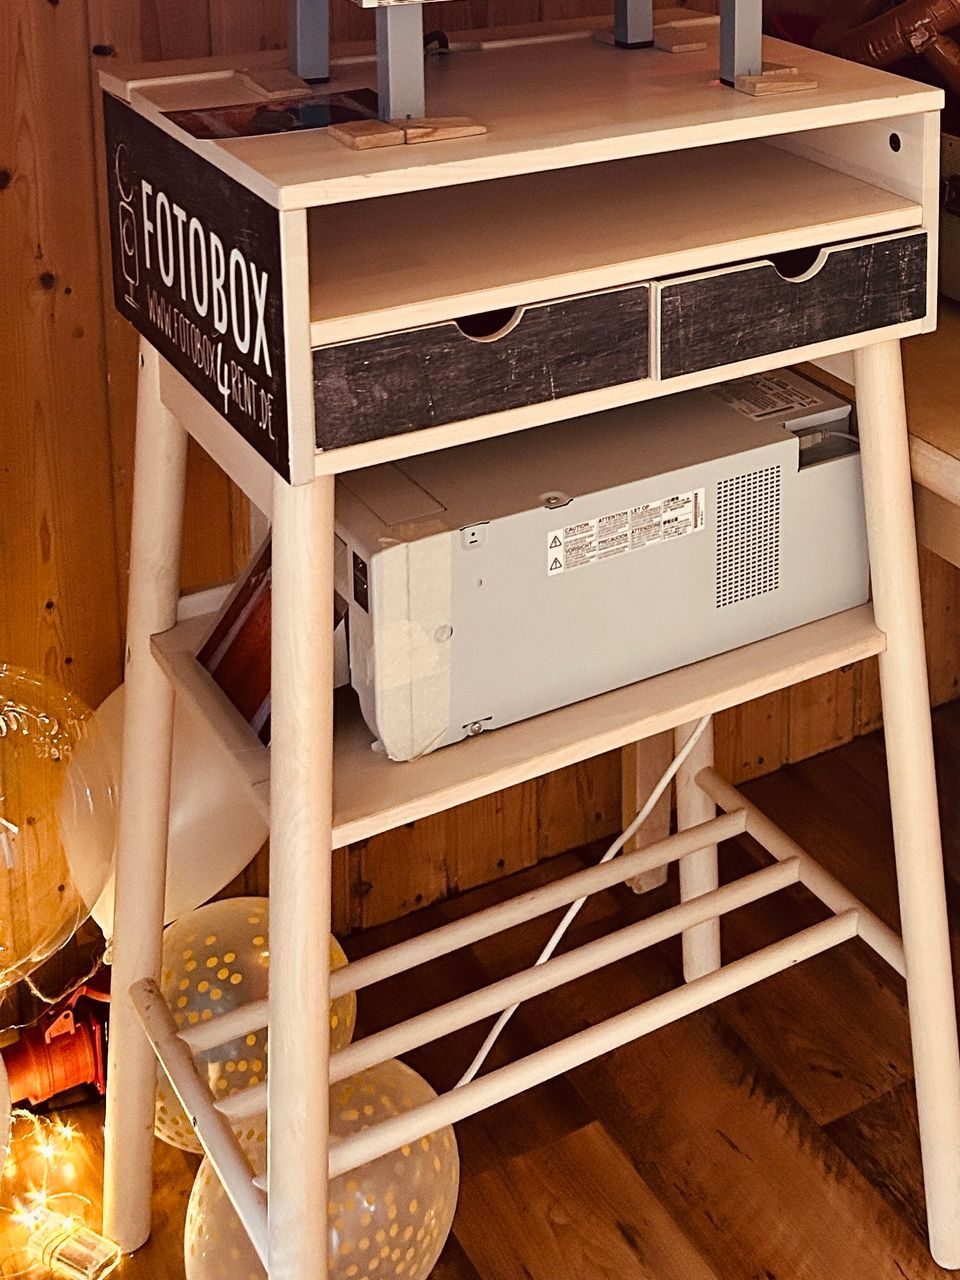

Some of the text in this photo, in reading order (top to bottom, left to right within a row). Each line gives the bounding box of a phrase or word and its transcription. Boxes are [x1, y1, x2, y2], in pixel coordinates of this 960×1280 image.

[141, 179, 272, 378] FOTOBOX
[598, 511, 628, 524] ATTENTION
[564, 522, 590, 534] CAUTION
[565, 541, 592, 555] VORSICHT
